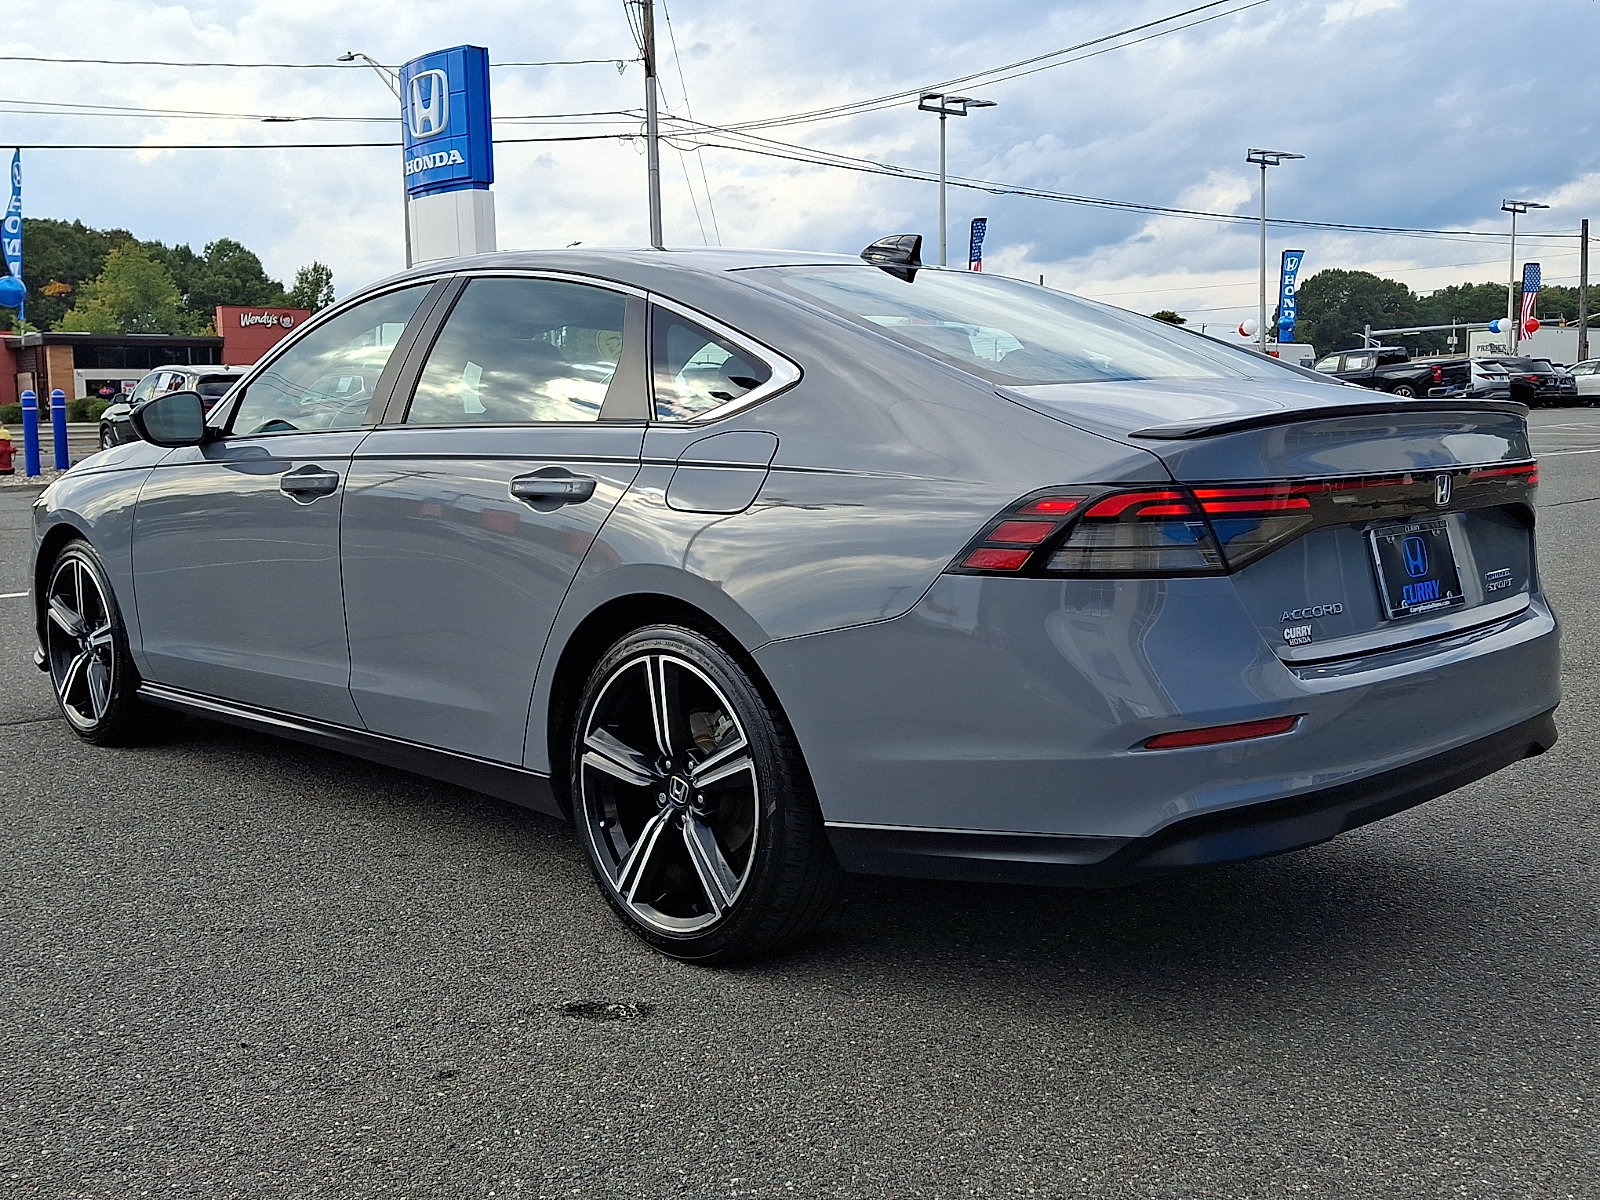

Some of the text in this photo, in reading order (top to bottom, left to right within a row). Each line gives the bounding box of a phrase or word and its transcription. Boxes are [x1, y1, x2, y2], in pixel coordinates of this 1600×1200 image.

[405, 150, 465, 176] HONDA
[1283, 275, 1295, 320] HOND
[240, 311, 278, 328] Wendy's
[1403, 579, 1440, 605] CURRY
[1279, 602, 1343, 623] ACCORD
[1283, 624, 1312, 640] CURRY
[1288, 635, 1312, 646] HONDA
